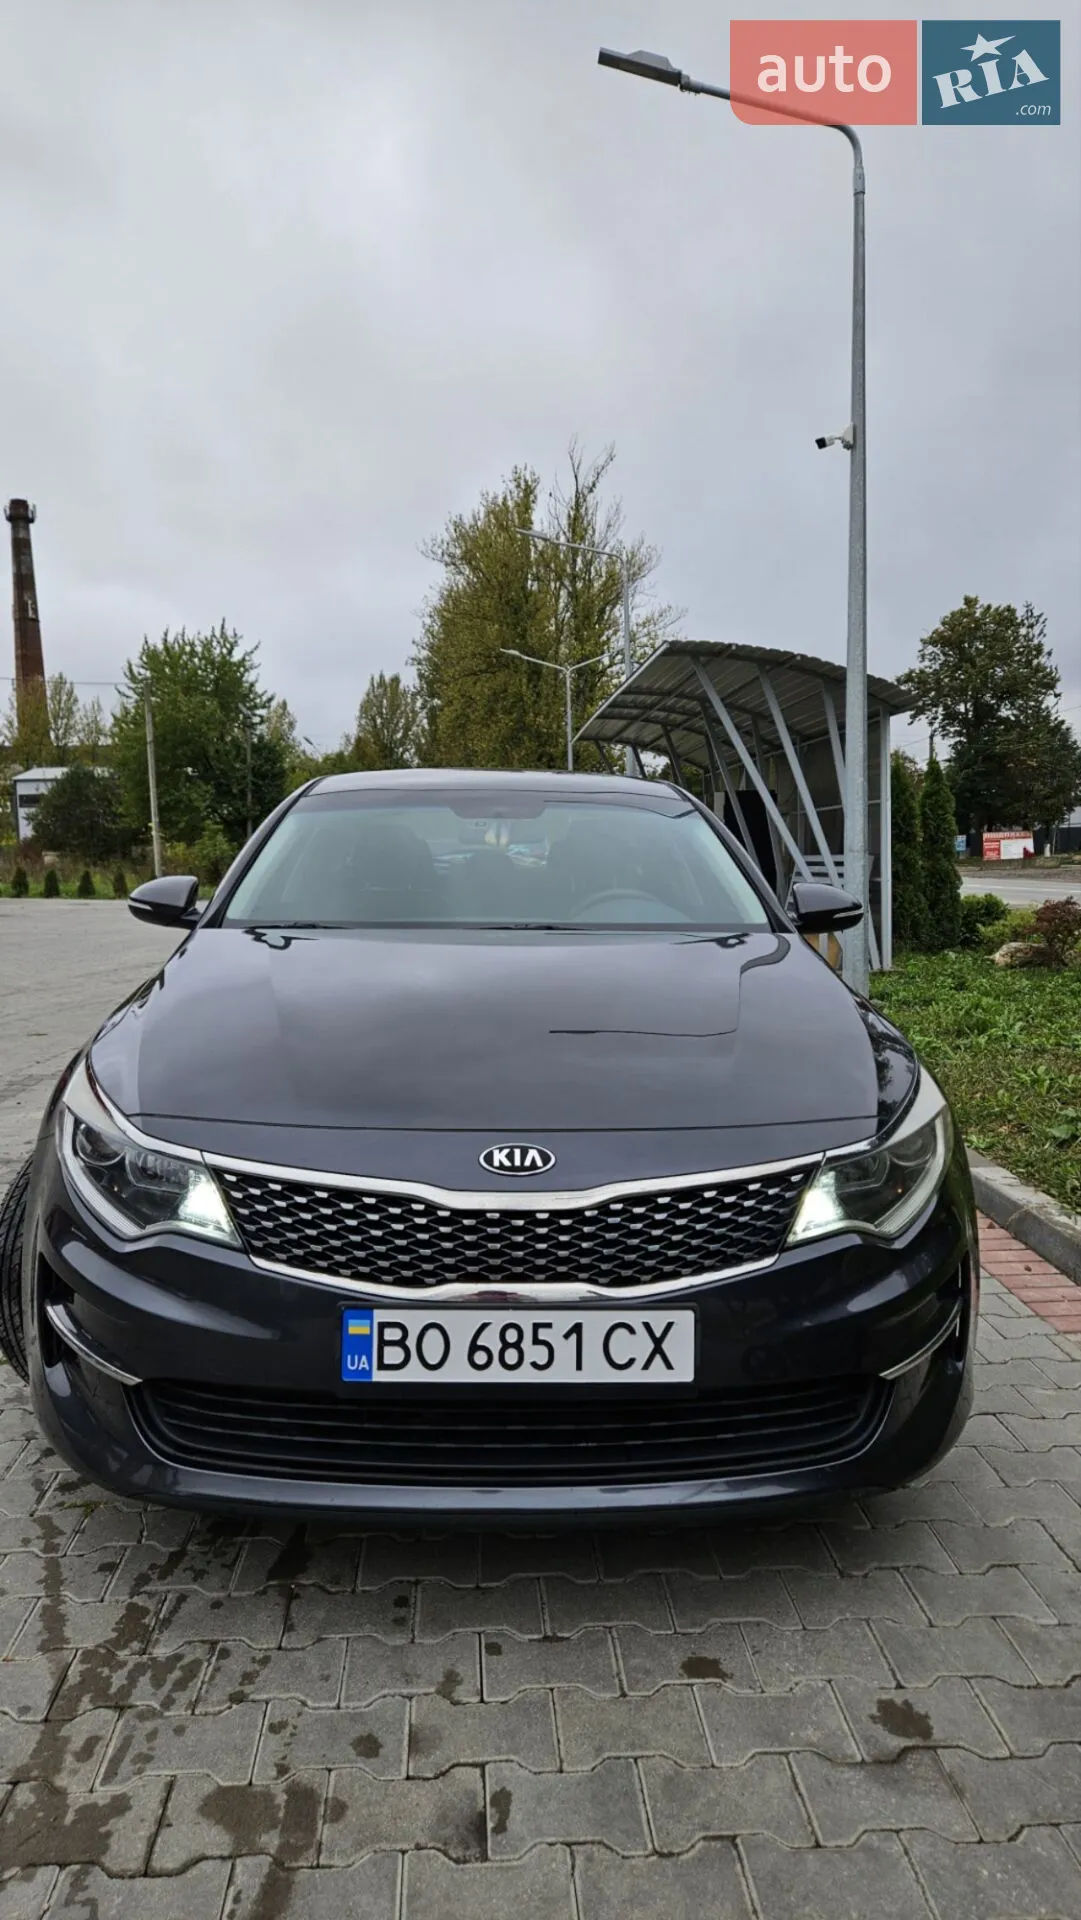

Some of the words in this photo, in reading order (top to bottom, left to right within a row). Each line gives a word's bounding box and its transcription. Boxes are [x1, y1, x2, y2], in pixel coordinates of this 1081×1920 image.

[492, 1148, 544, 1167] KIA
[376, 1321, 451, 1372] BO
[467, 1321, 583, 1372] 6851
[602, 1321, 675, 1372] CX
[347, 1355, 370, 1371] UA
